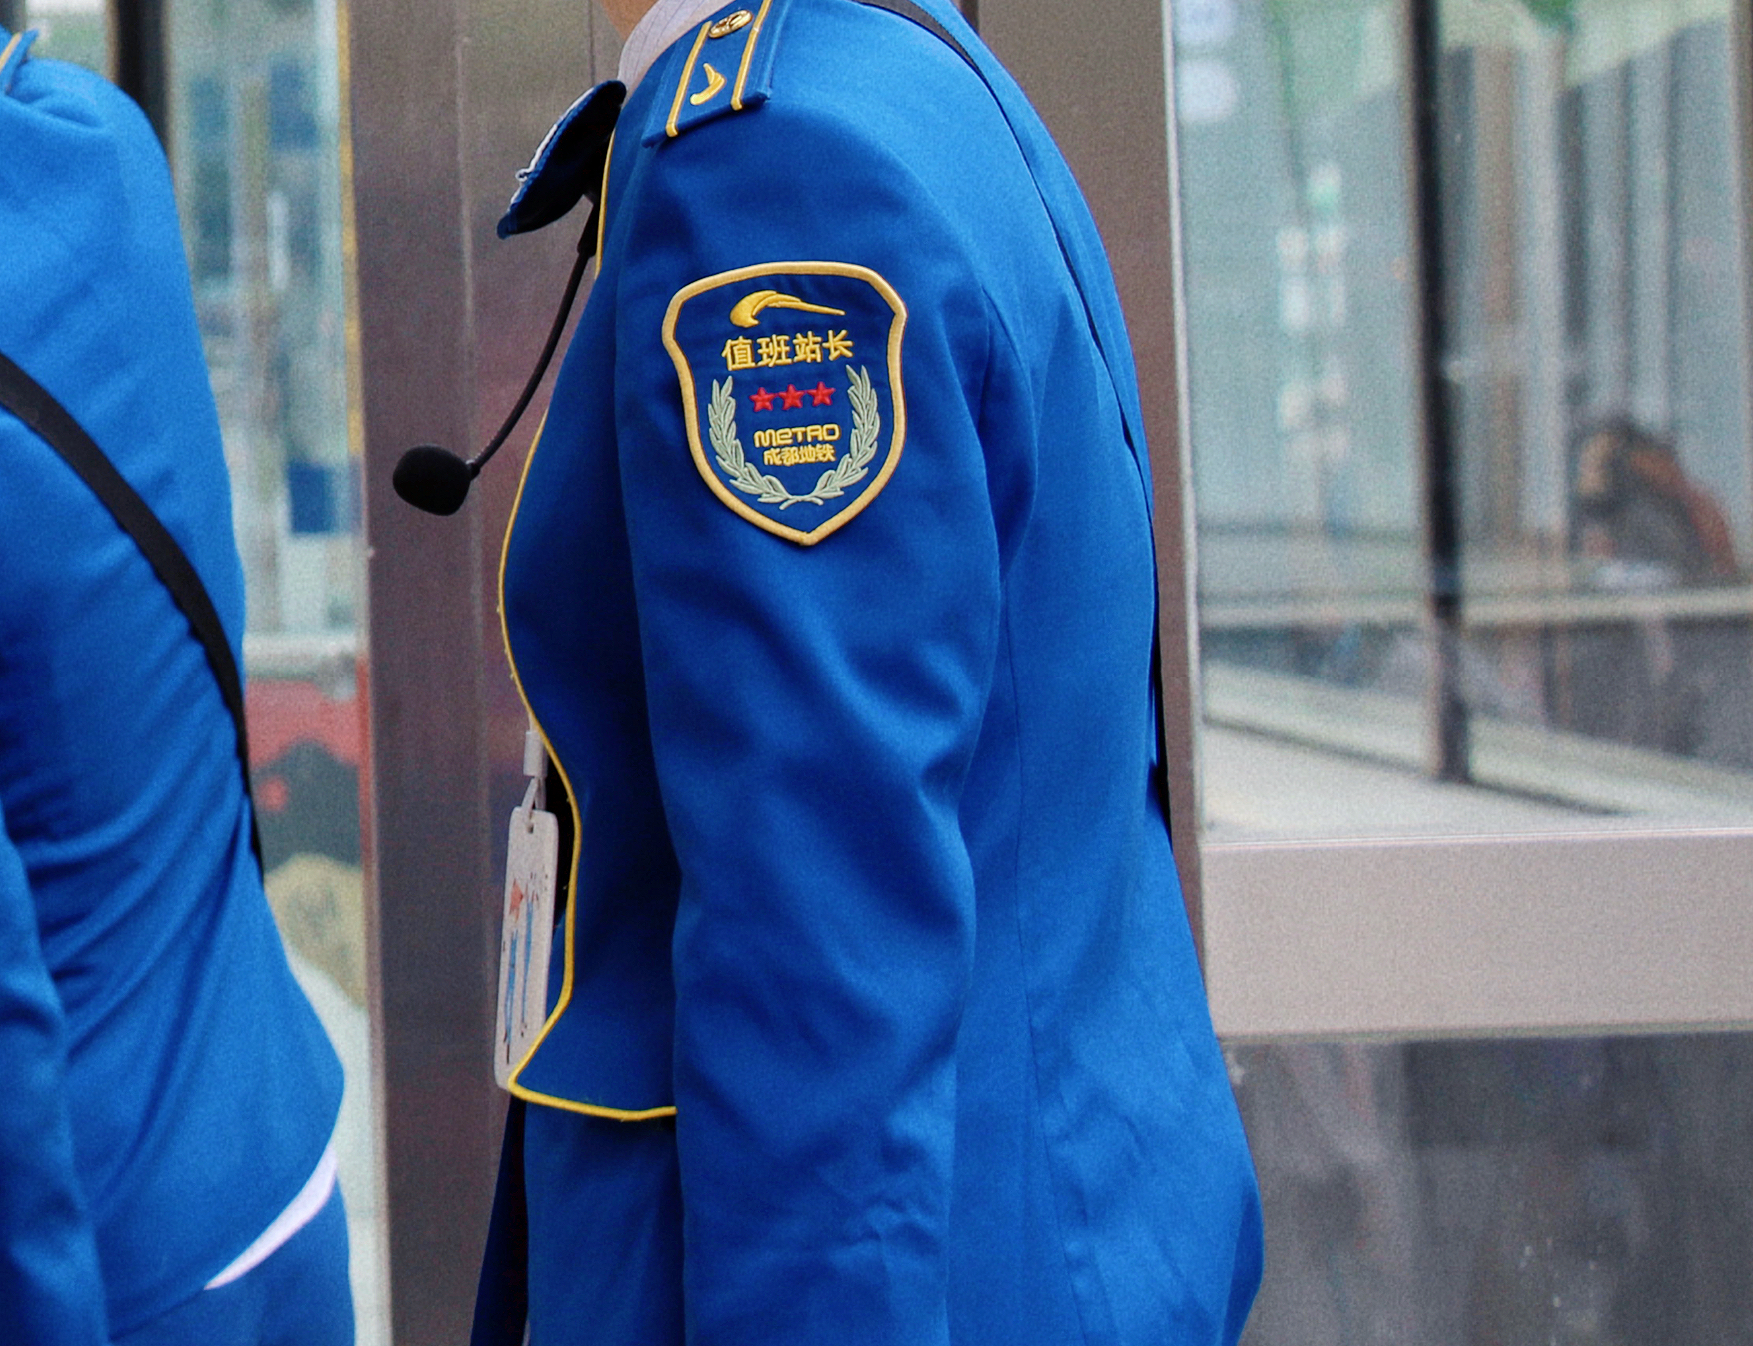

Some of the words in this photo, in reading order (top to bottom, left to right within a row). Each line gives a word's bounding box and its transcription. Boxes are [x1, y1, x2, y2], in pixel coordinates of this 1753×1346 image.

[721, 329, 854, 371] 值班站长
[753, 423, 840, 447] METRO
[763, 443, 836, 466] 成都地铁
